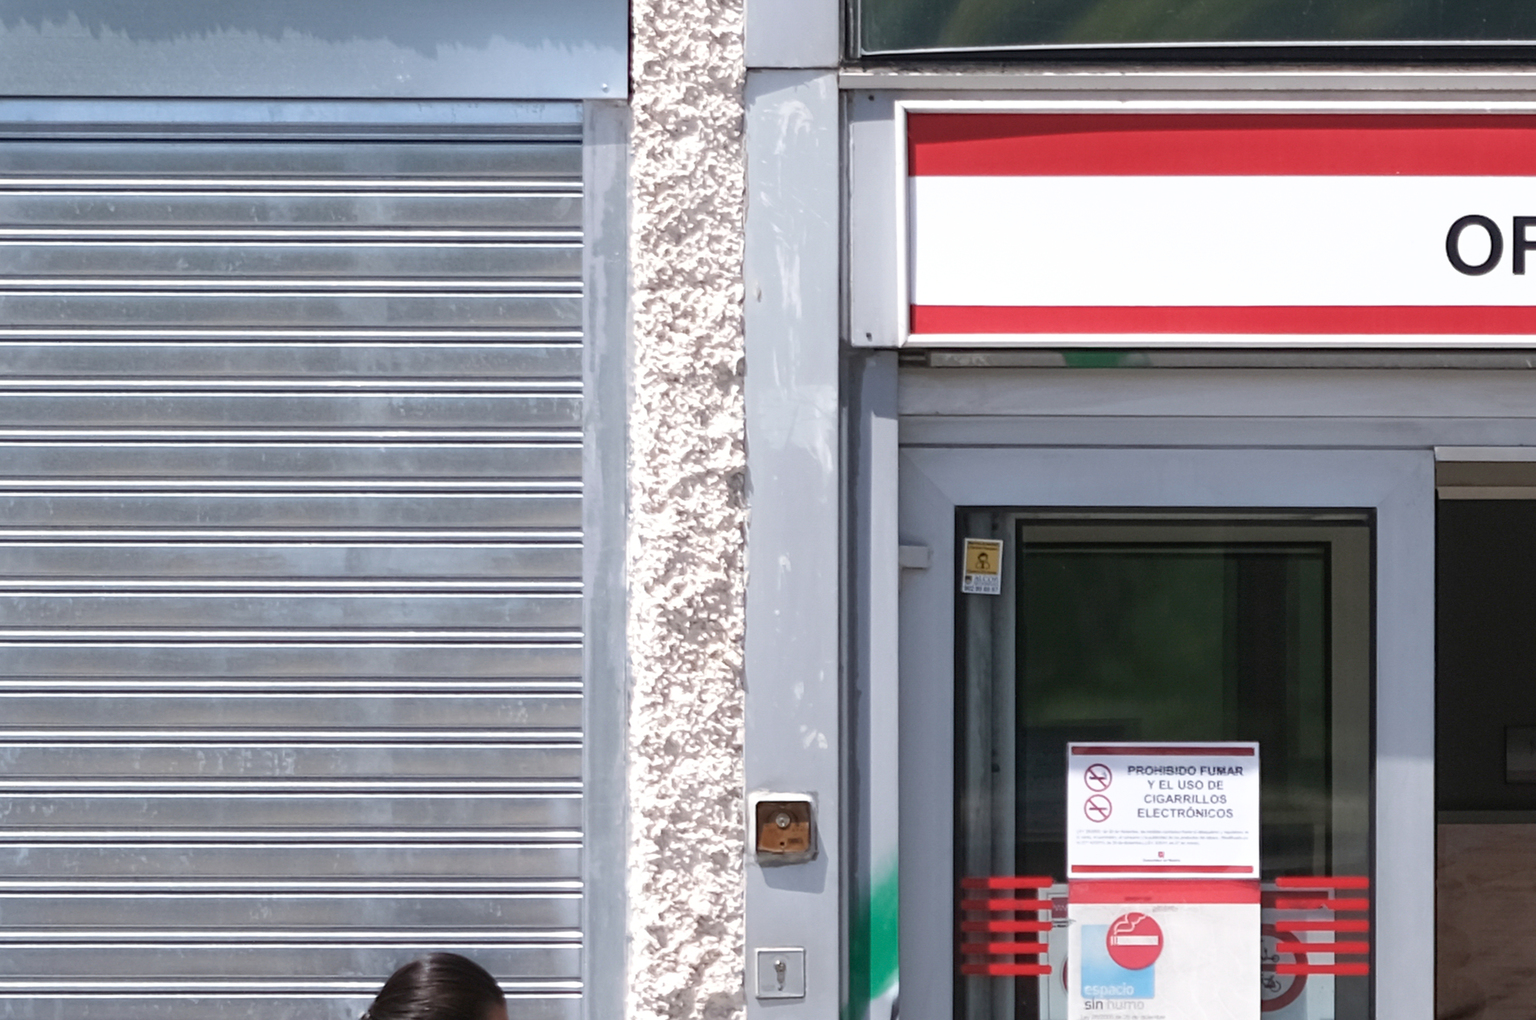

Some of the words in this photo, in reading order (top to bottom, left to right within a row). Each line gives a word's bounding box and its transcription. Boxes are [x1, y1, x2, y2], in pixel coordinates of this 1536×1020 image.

[1127, 765, 1197, 776] PROHIBIDO
[1200, 765, 1244, 776] FUMAR
[1147, 780, 1155, 790] Y
[1159, 780, 1174, 790] EL
[1178, 780, 1204, 790] USO
[1208, 780, 1224, 790] DE
[1144, 794, 1227, 804] CIGARRILLOS
[1137, 807, 1234, 818] ELECTRÓNICOS
[1084, 982, 1135, 997] espacio
[1084, 998, 1104, 1010] sin
[1106, 999, 1145, 1010] humo
